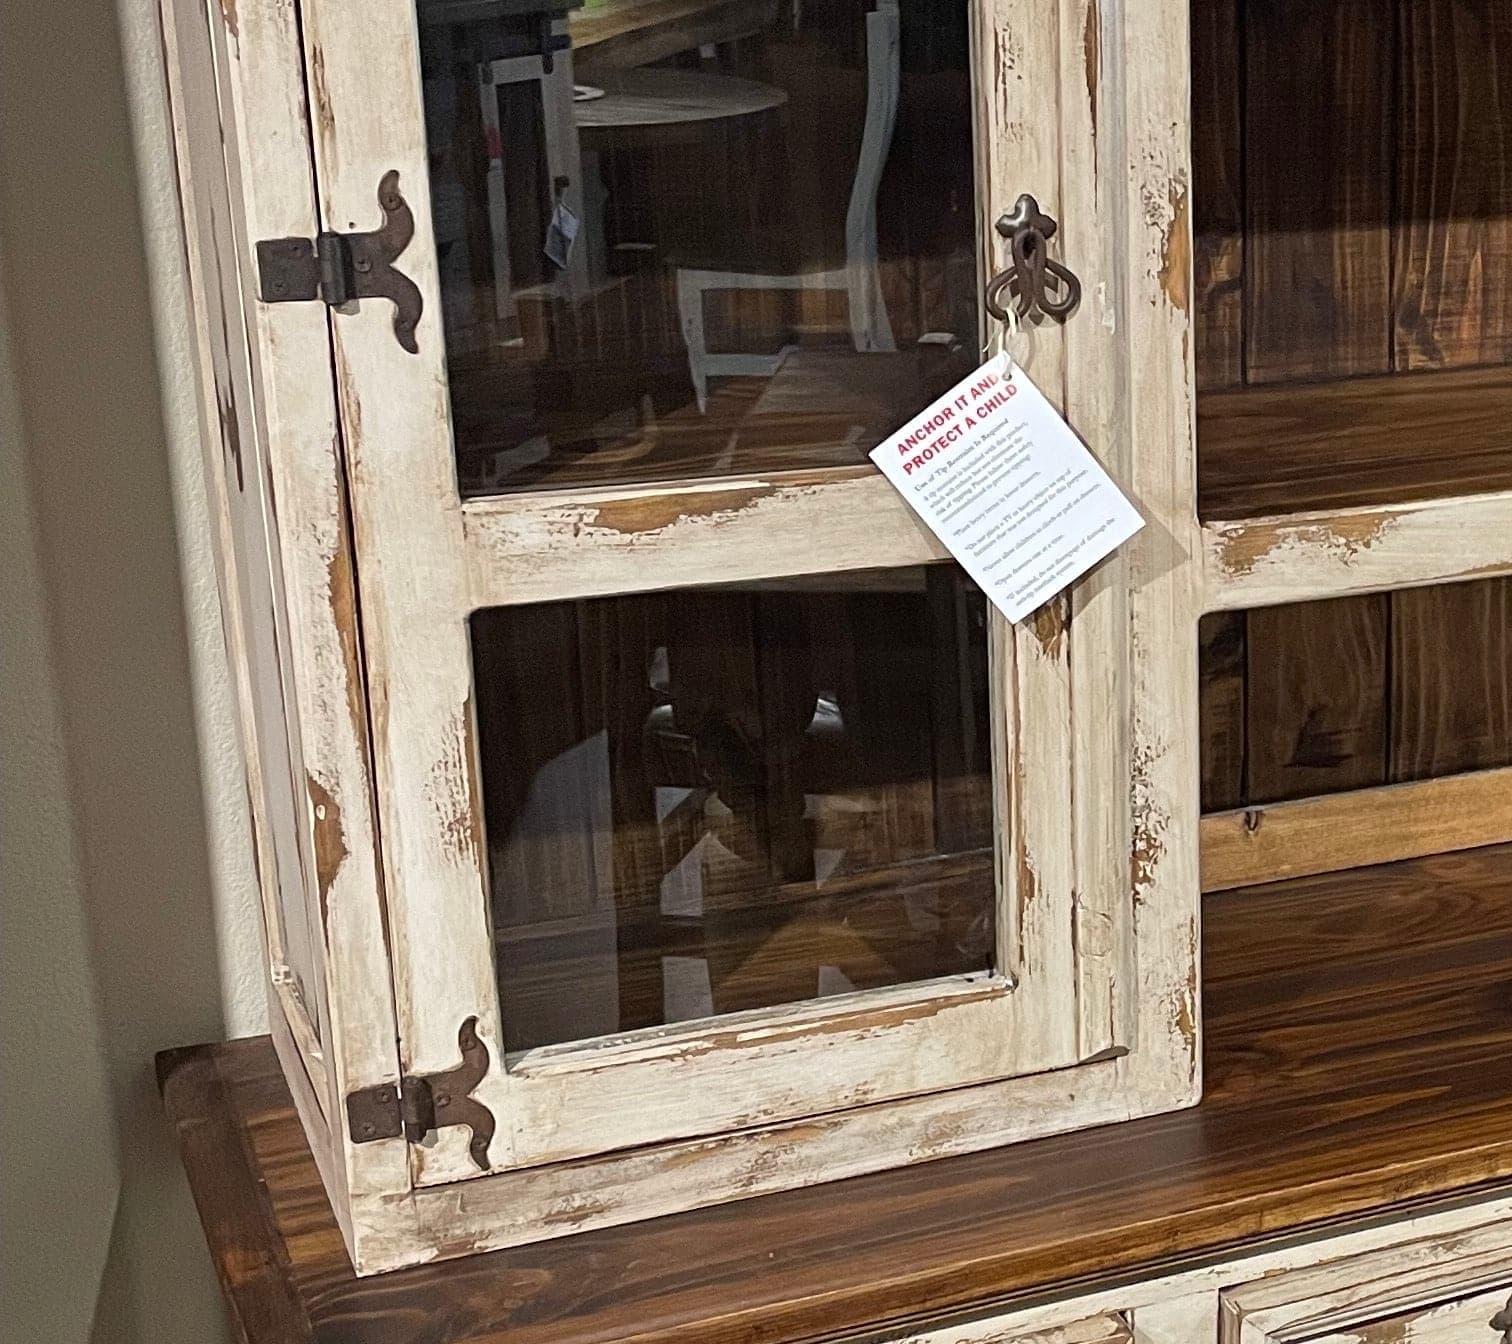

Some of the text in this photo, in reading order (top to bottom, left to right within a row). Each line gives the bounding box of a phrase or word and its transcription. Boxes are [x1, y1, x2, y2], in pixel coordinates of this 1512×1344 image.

[897, 375, 999, 456] ANCHOR IT AND
[902, 384, 1017, 476] PROTECT A CHILD
